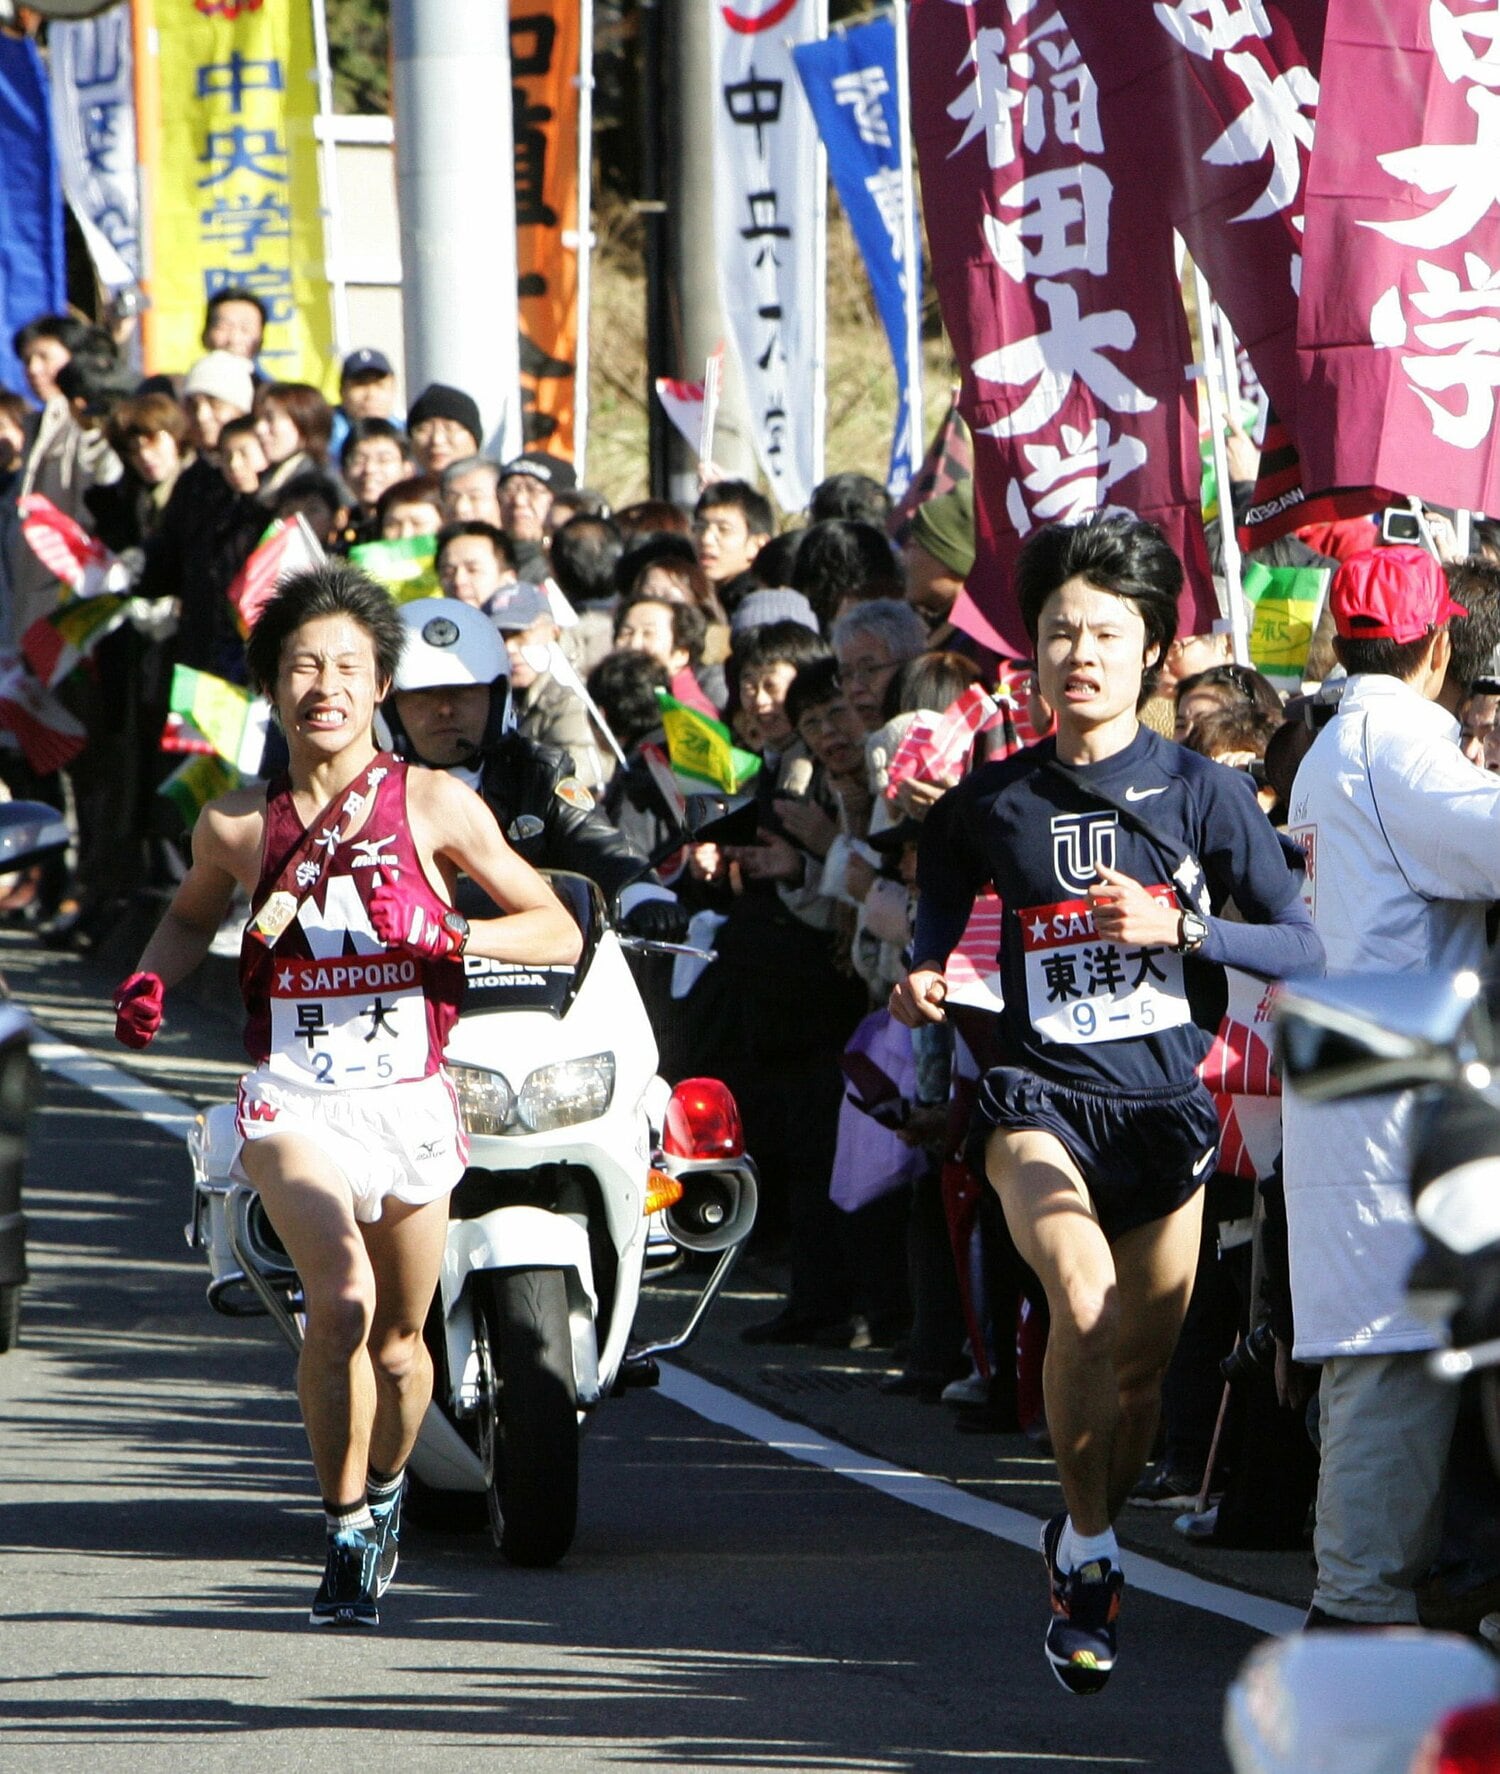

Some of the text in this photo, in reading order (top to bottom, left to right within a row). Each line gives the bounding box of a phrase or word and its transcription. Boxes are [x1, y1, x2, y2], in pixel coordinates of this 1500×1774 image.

[301, 960, 416, 991] SAPPORO
[468, 974, 546, 989] HONDA
[1041, 944, 1168, 1002] 東洋大
